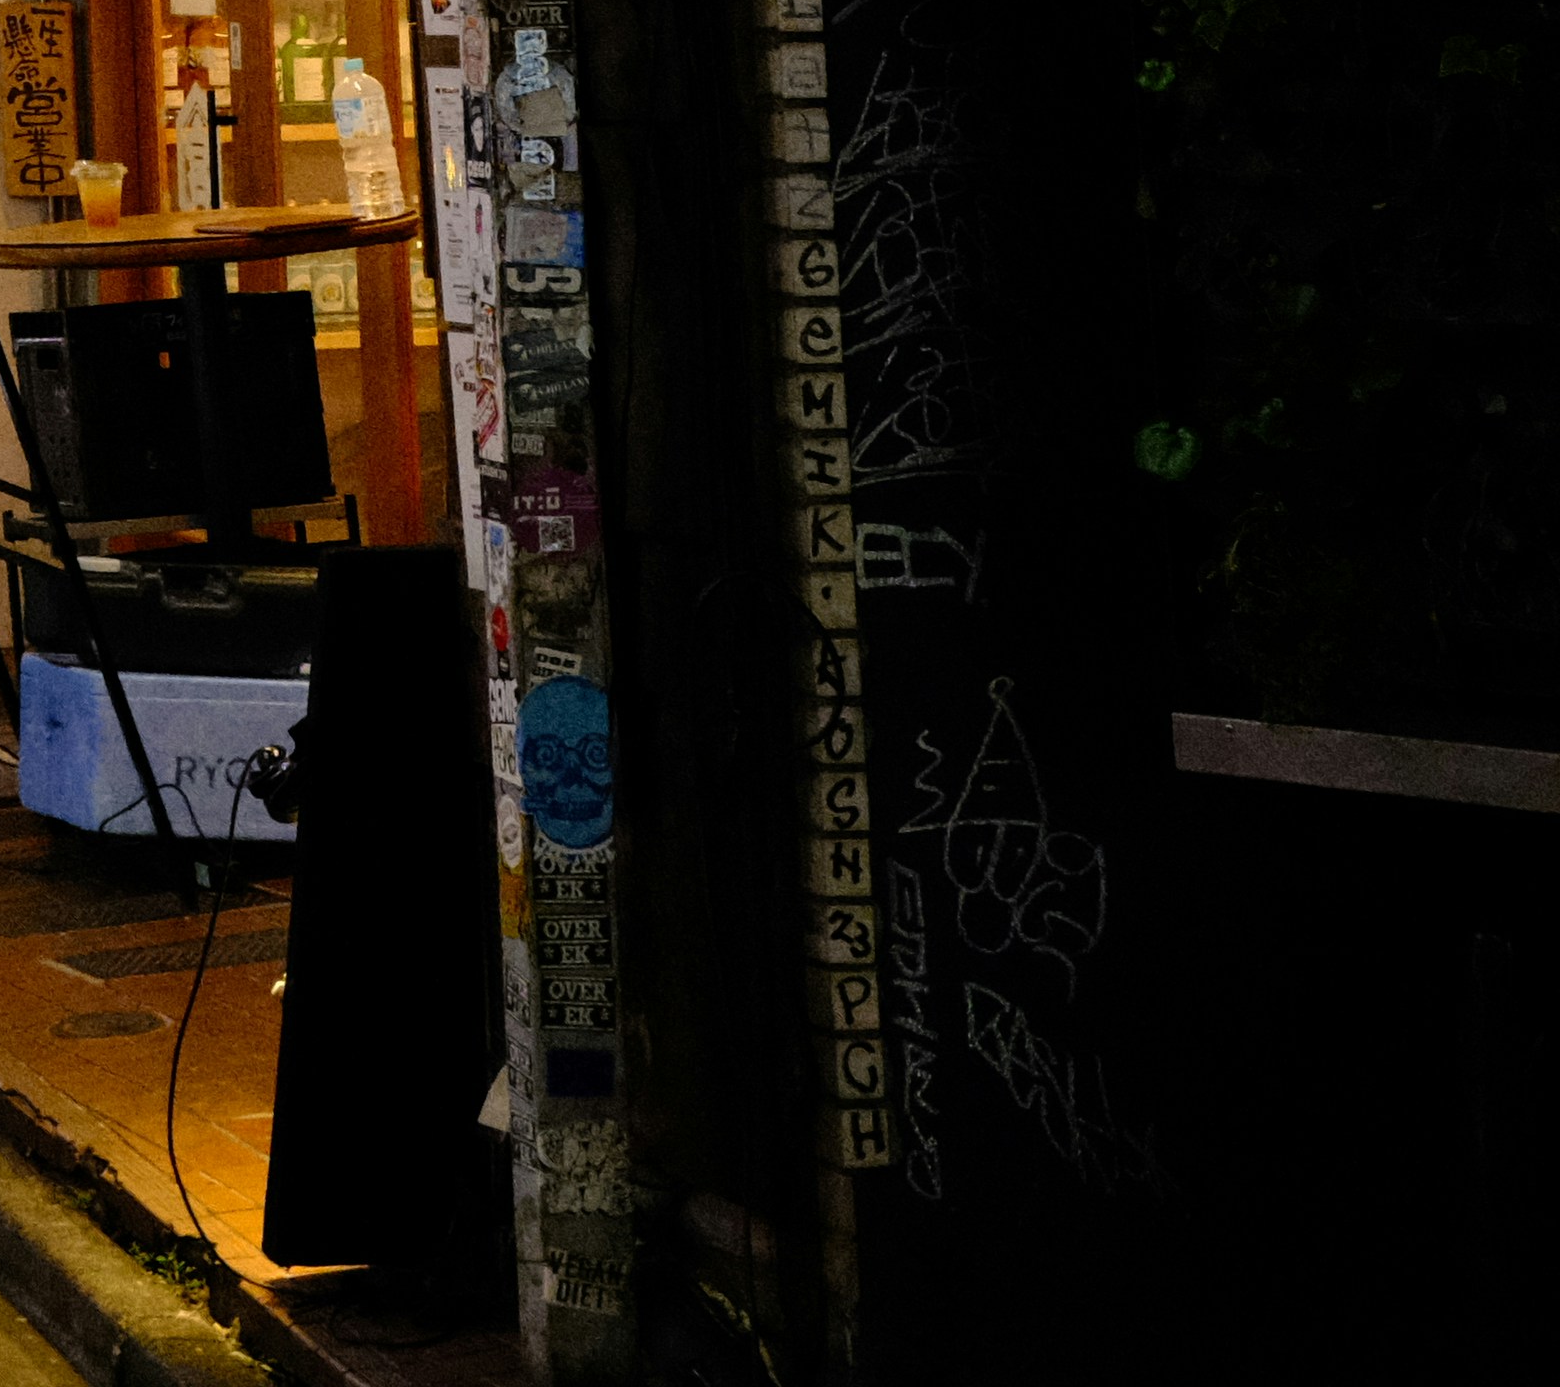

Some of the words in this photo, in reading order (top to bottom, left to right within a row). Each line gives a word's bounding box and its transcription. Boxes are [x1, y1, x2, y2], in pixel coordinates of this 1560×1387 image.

[7, 75, 69, 193] 営業中
[541, 919, 606, 940] OVER
[547, 982, 608, 1003] OVER
